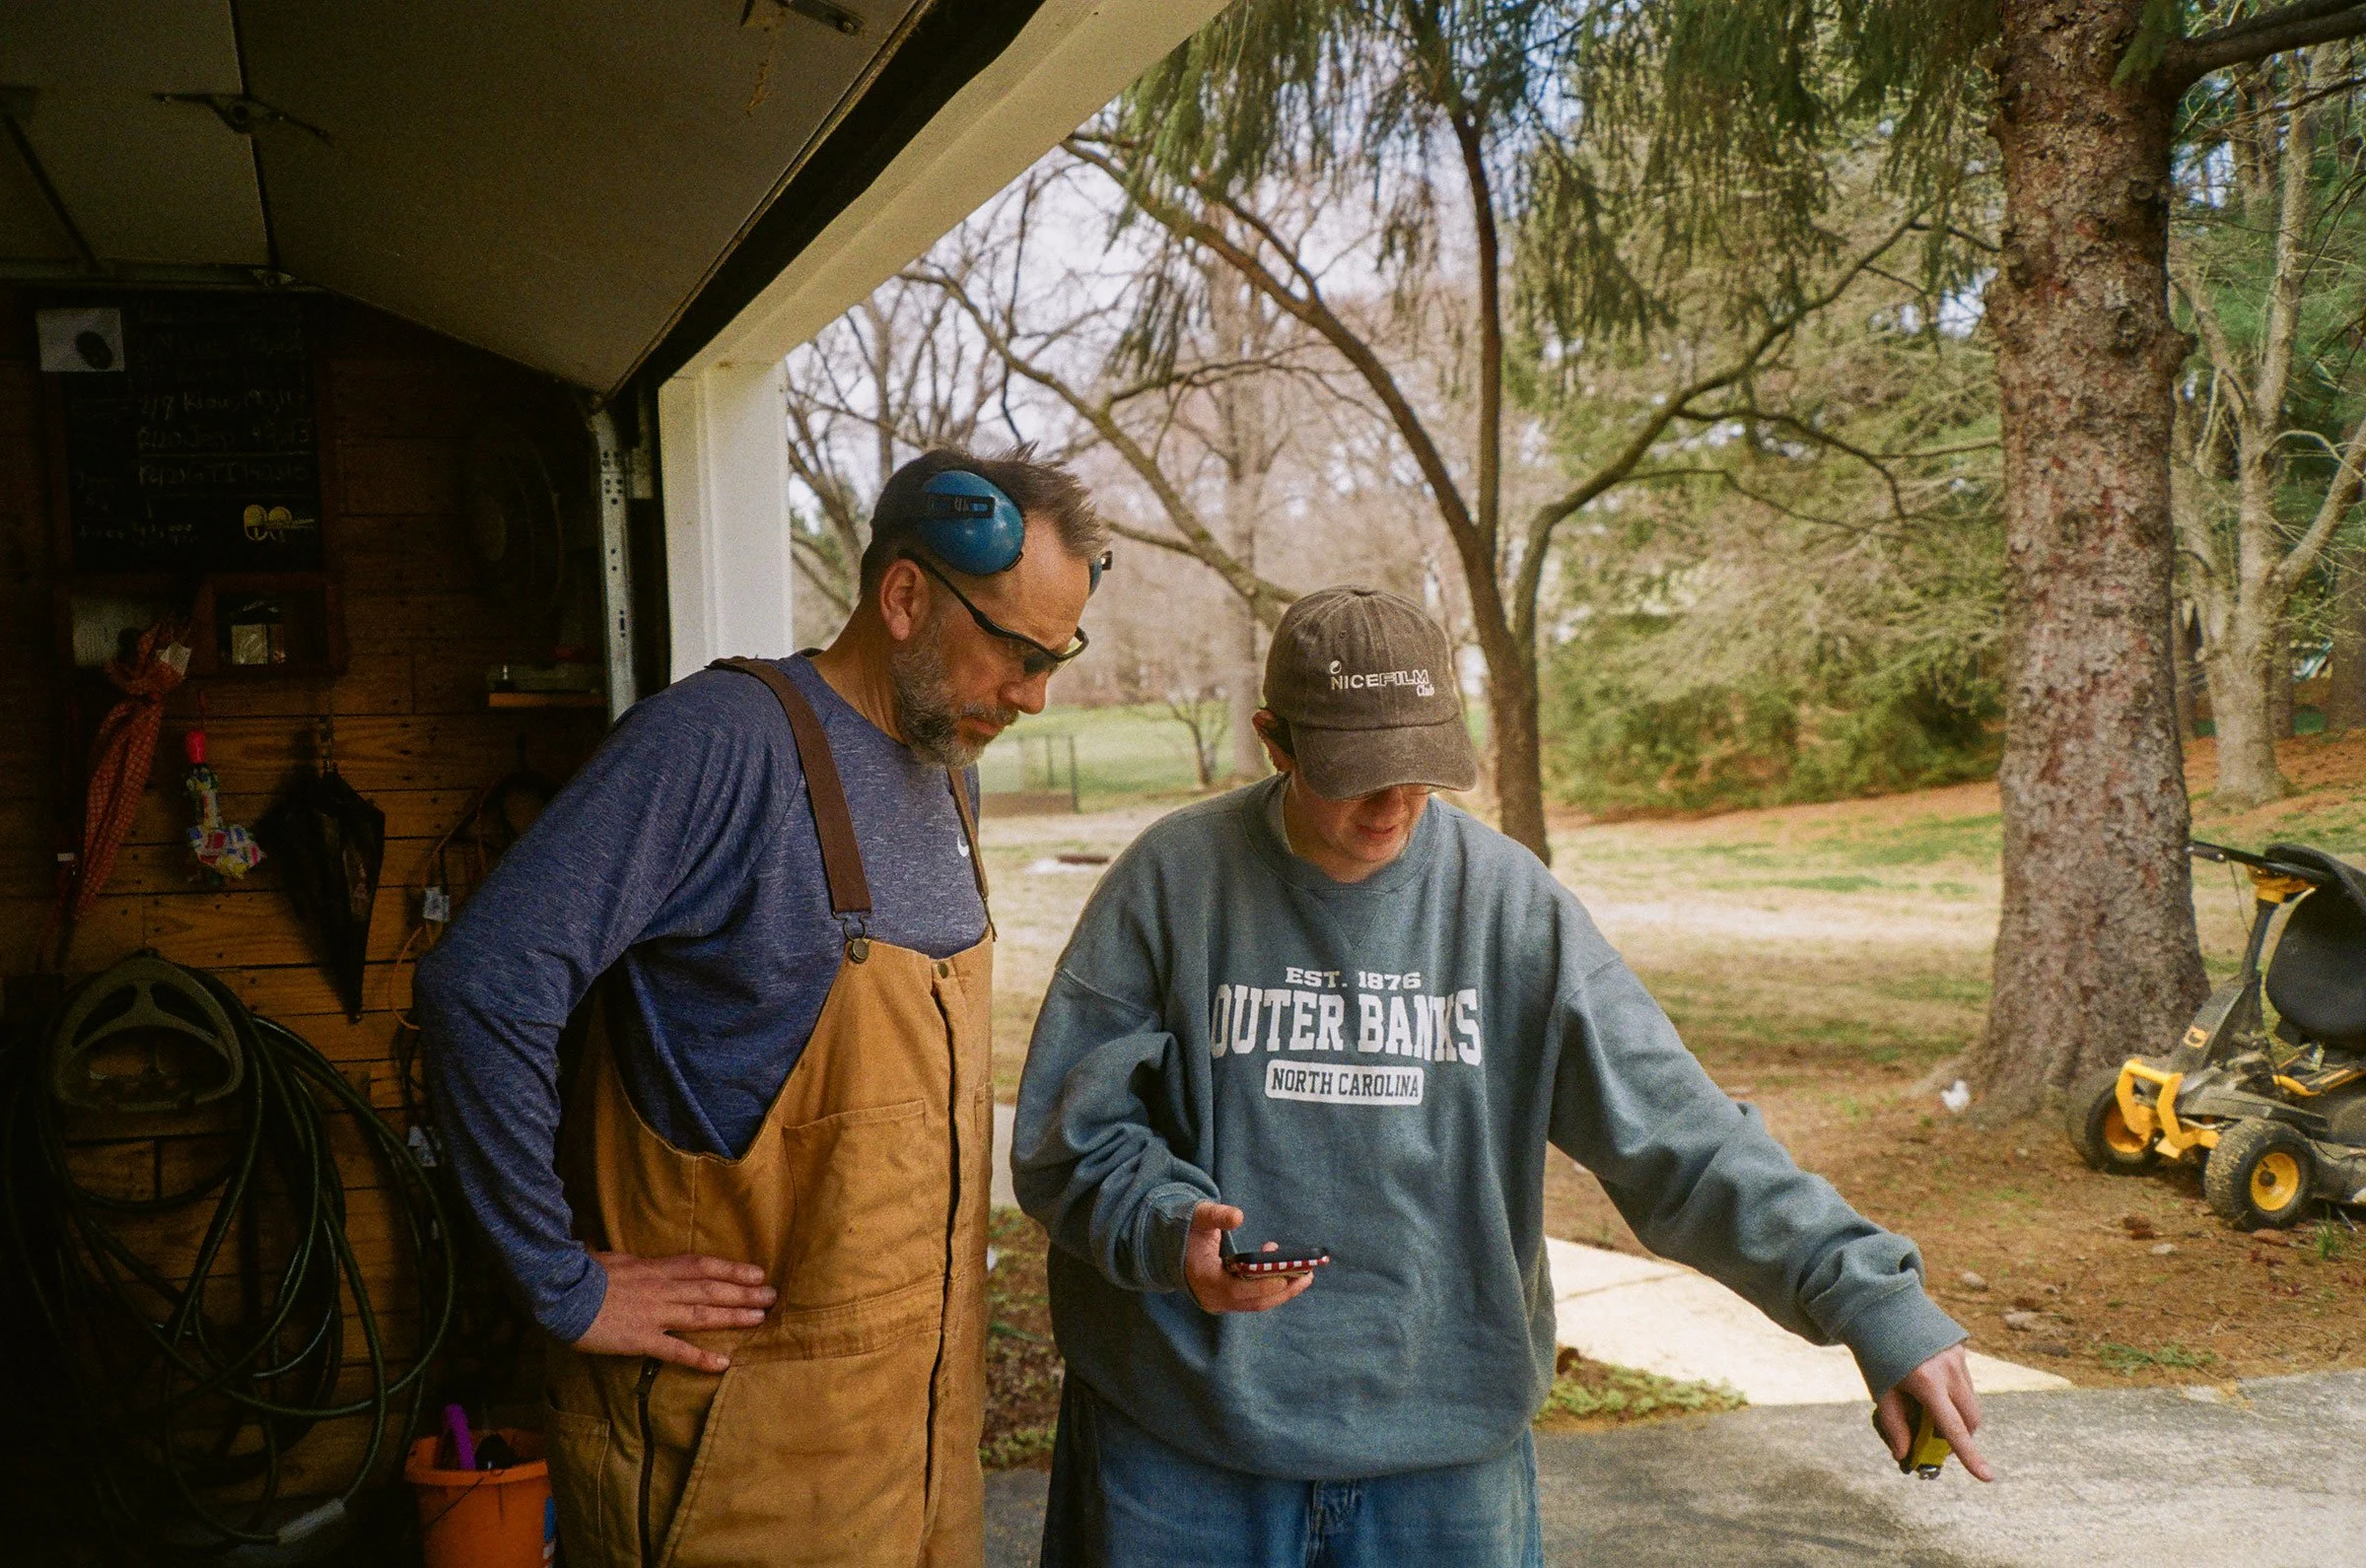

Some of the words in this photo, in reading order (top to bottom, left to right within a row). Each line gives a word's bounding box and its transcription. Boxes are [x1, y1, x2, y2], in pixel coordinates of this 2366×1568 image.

[1285, 967, 1348, 988] EST.
[1357, 971, 1422, 990] 1876
[1211, 984, 1345, 1058] OUTER
[1357, 989, 1482, 1066] BANKS
[1271, 1067, 1332, 1093] NORTH
[1338, 1072, 1420, 1098] CAROLINA
